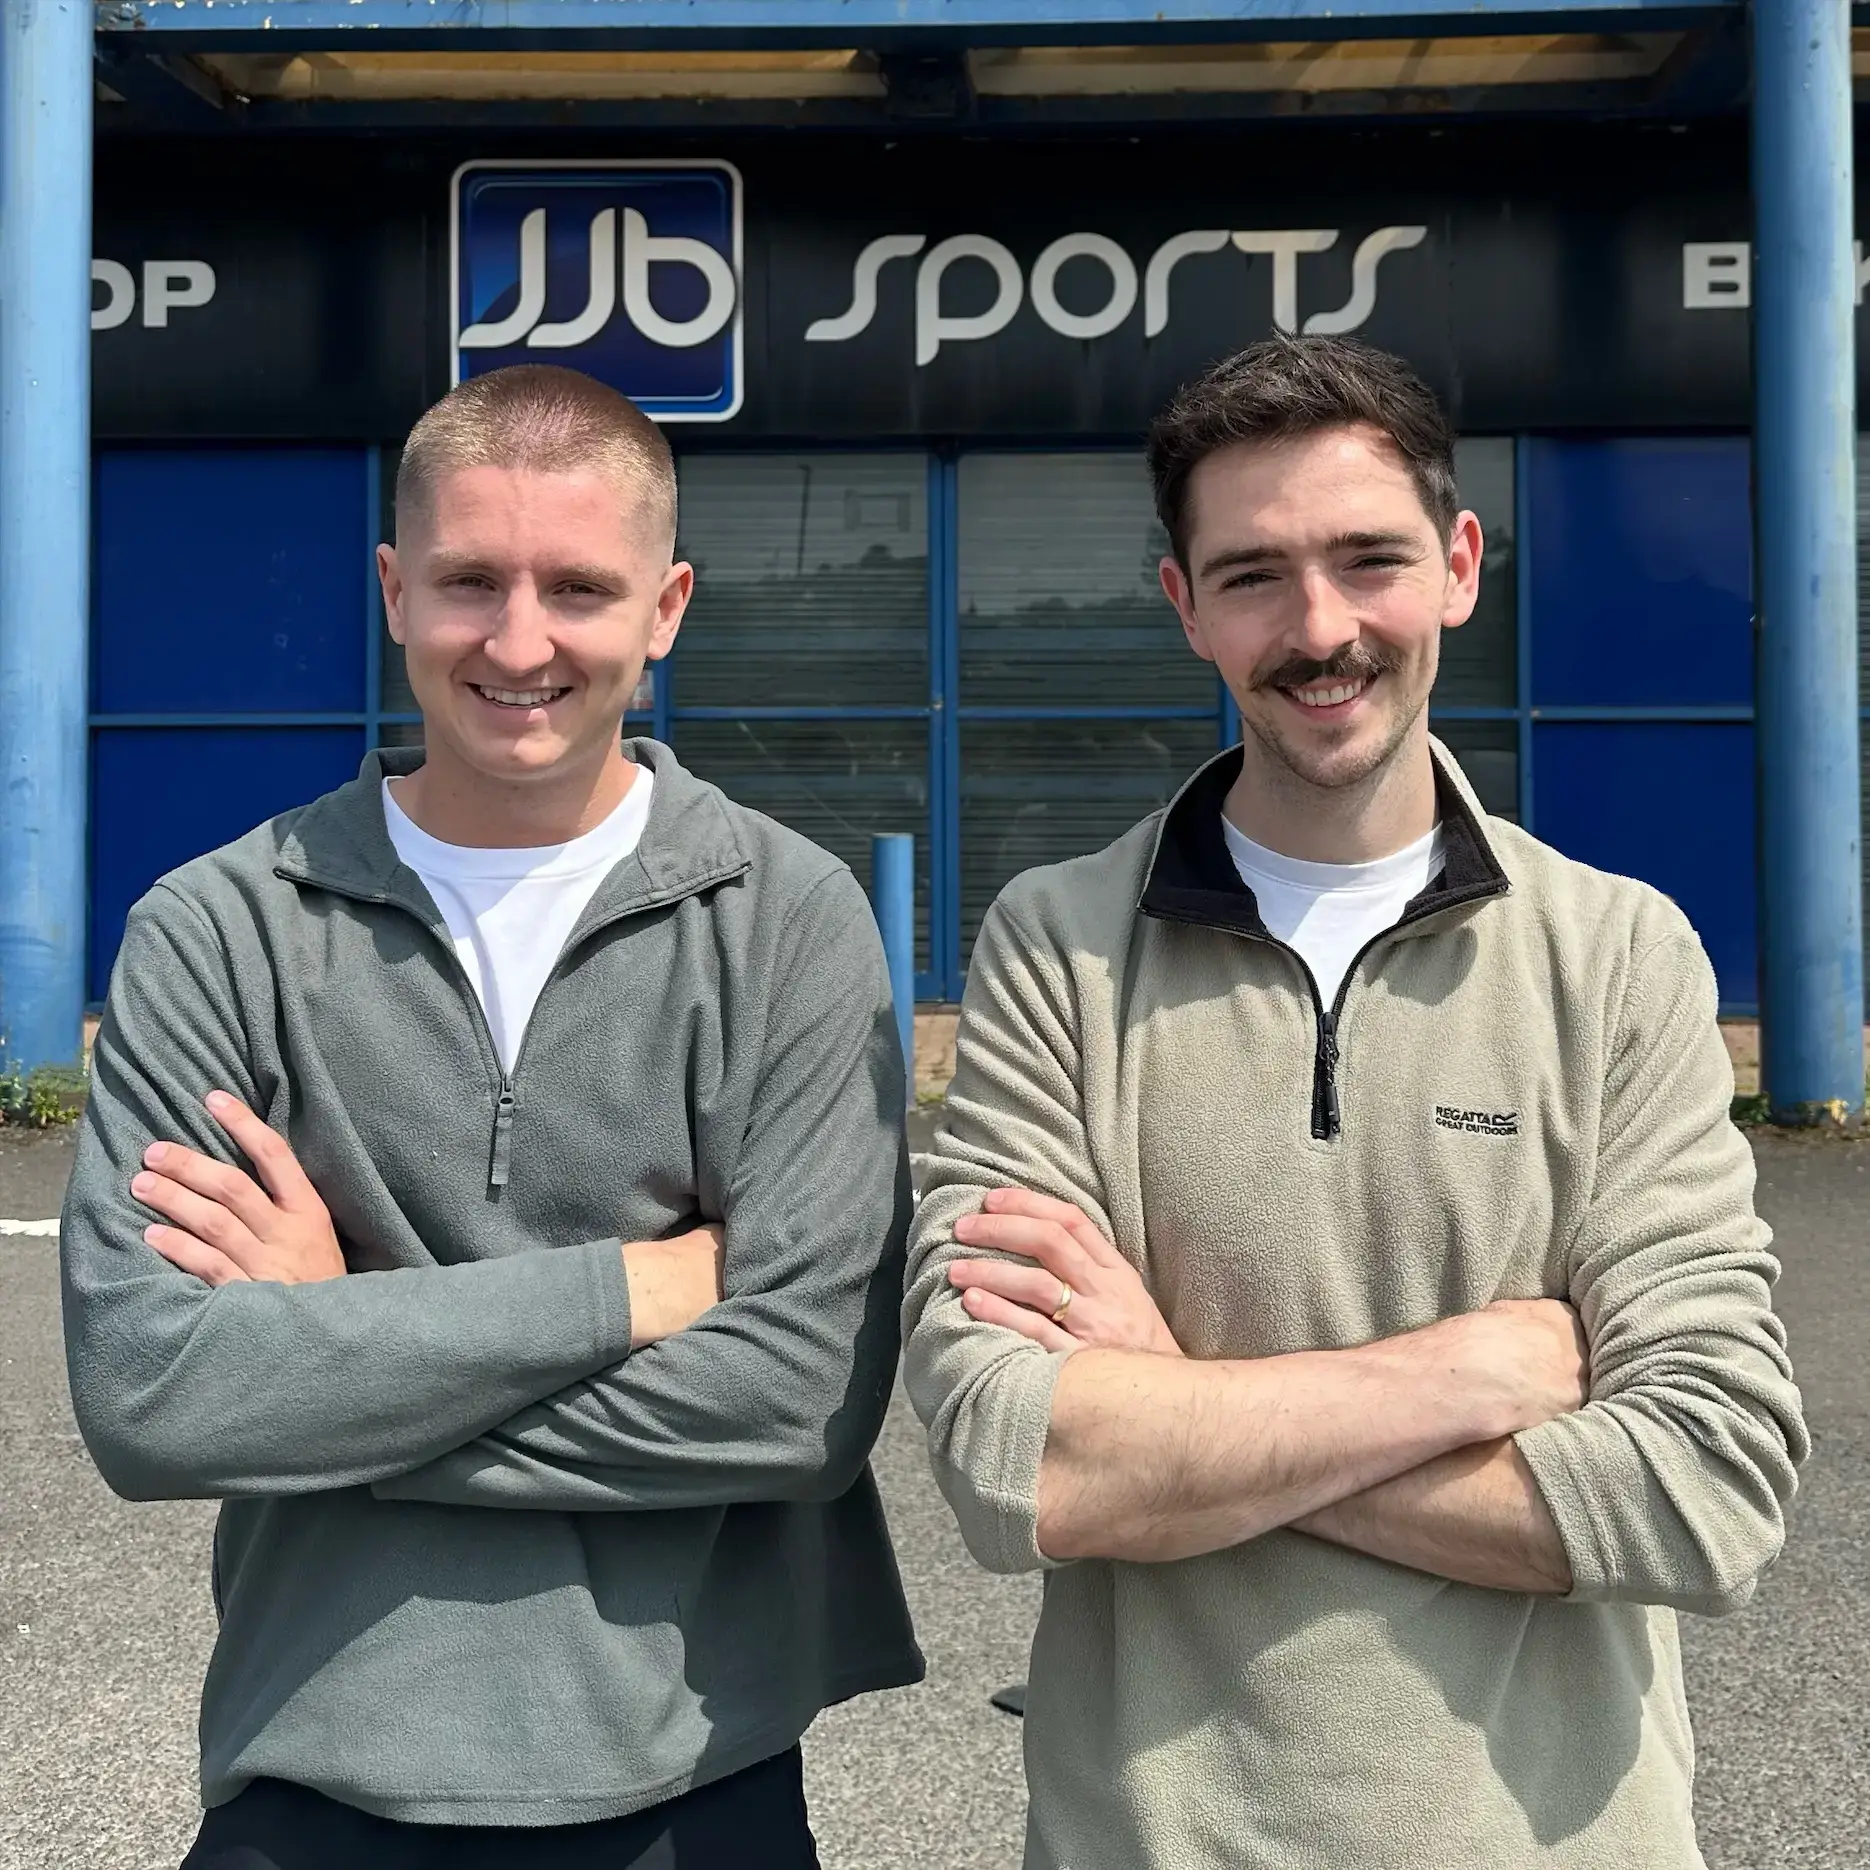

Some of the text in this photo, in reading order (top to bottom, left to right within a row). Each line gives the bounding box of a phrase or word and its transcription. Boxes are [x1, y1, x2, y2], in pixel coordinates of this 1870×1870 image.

[1435, 1105, 1491, 1126] REGATTA
[1435, 1117, 1519, 1136] GREAT OUTDOORS
